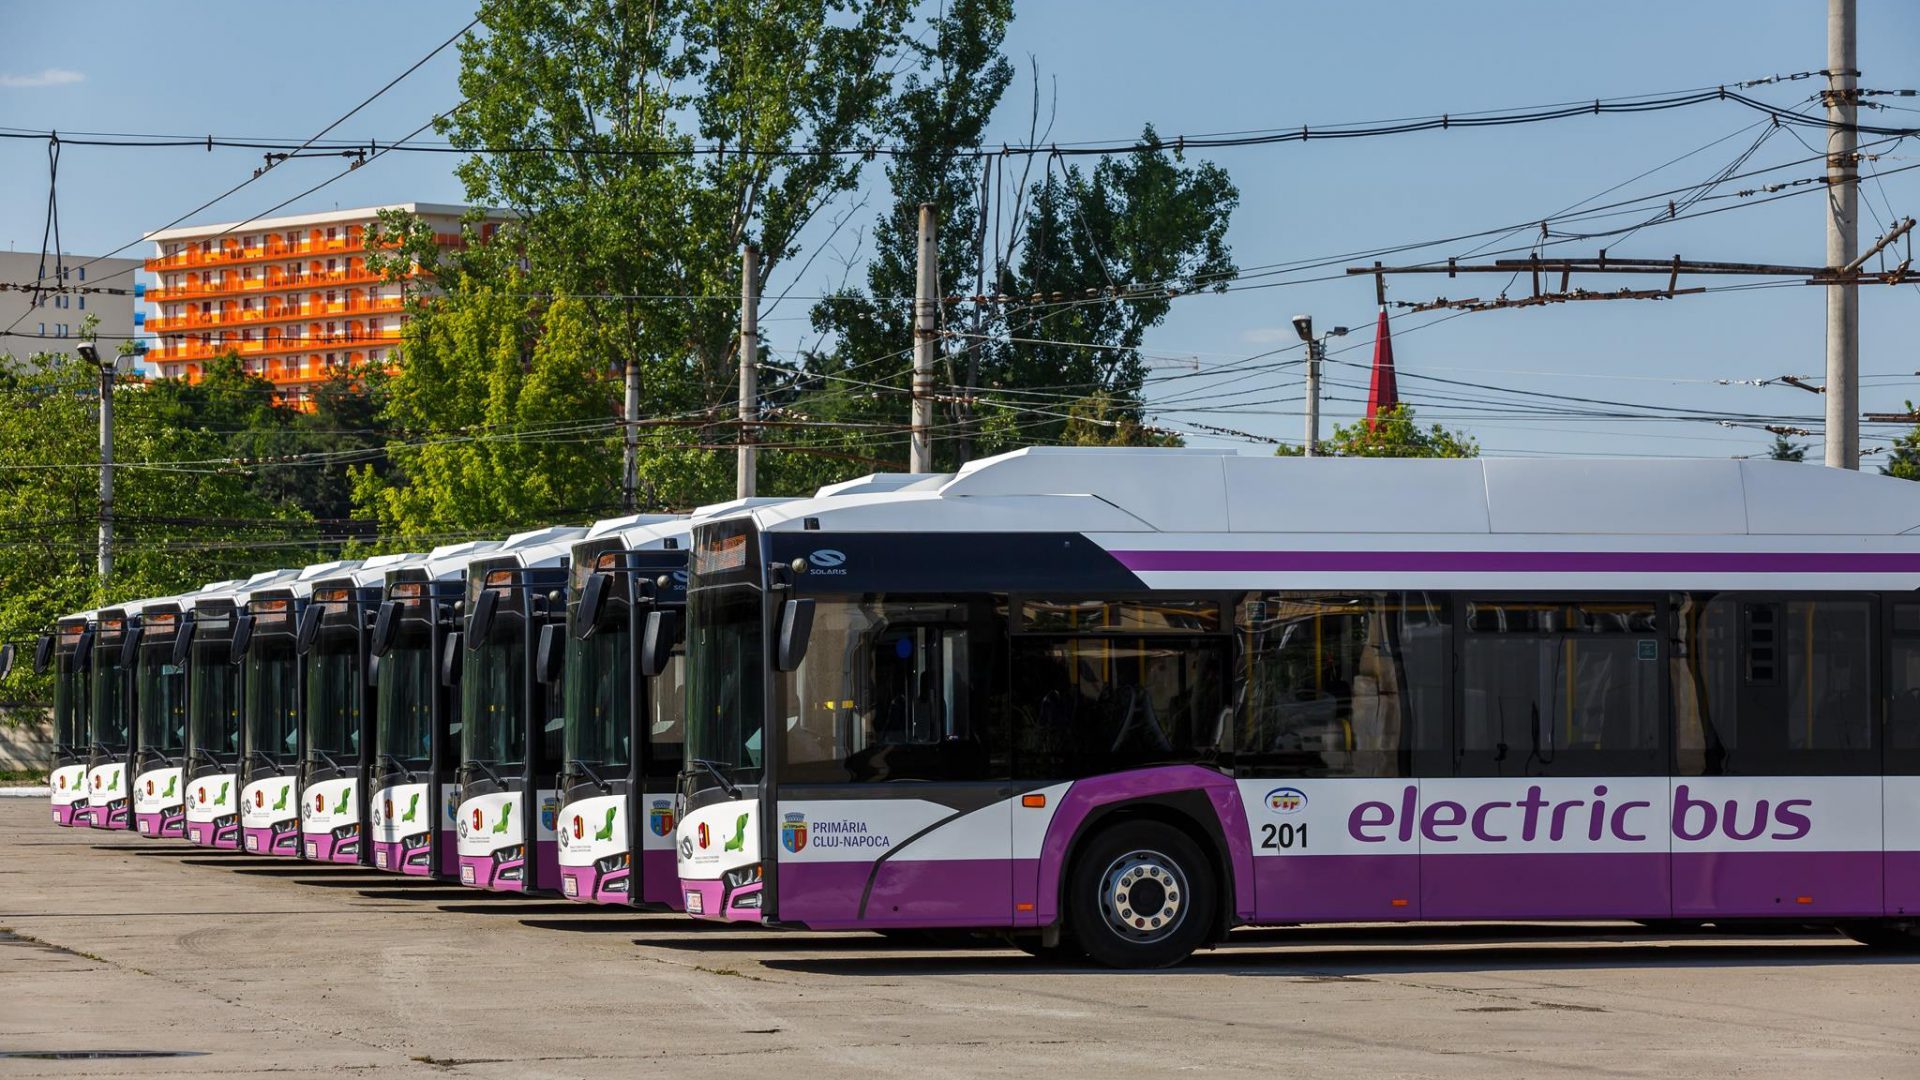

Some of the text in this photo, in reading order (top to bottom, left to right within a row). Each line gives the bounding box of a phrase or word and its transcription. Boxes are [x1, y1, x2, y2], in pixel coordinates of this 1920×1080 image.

[1348, 784, 1813, 842] electric bus
[813, 820, 867, 833] PRIMĂRIA
[1261, 823, 1307, 848] 201
[813, 836, 889, 847] CLUJ-NAPOCA
